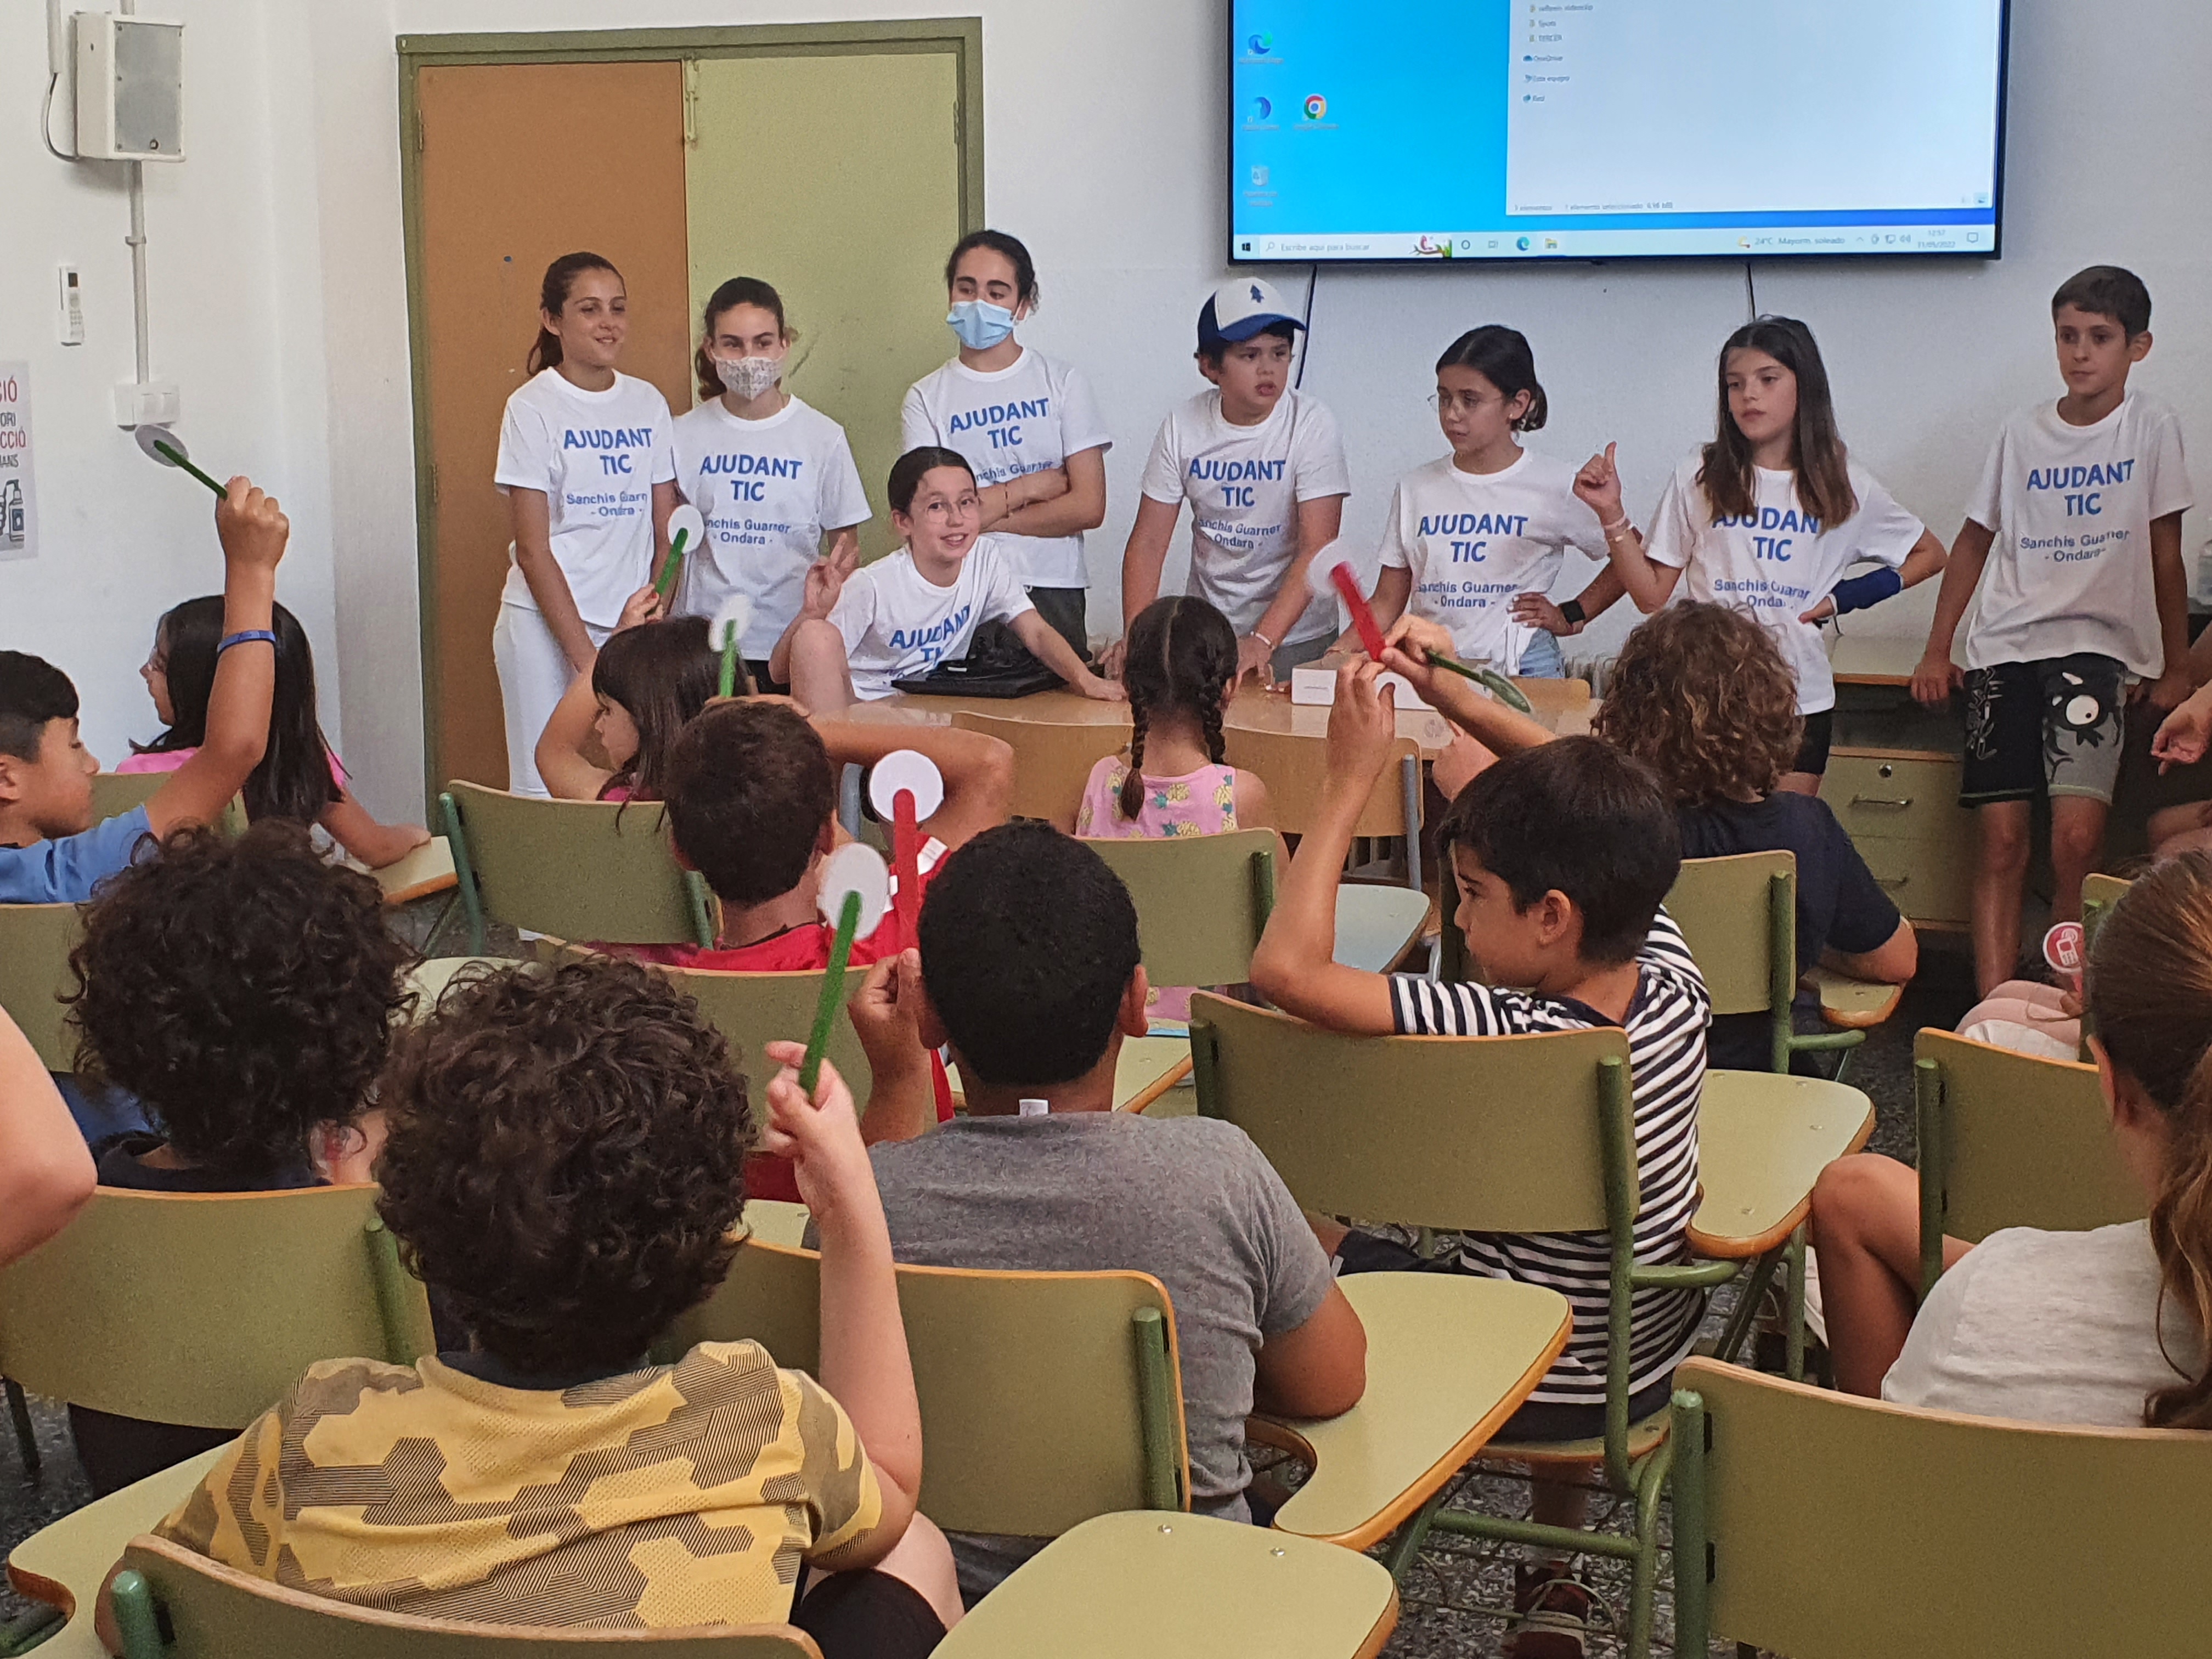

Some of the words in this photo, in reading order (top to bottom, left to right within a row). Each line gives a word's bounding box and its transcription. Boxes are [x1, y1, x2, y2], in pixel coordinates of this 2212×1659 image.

[1281, 243, 1306, 251] Escribe
[1345, 243, 1369, 251] buscar
[950, 397, 1049, 434] AJUDANT
[563, 428, 652, 449] AJUDANT
[988, 426, 1023, 449] TIC
[599, 453, 632, 476] TIC
[699, 454, 803, 480] AJUDANT
[1188, 458, 1286, 482] AJUDANT
[2027, 459, 2135, 491] AJUDANT
[566, 493, 616, 505] Sanchis
[730, 479, 765, 501] TIC
[1221, 486, 1256, 507] TIC
[2064, 493, 2102, 517] TIC
[1235, 523, 1282, 536] Guarner
[1417, 514, 1529, 537] AJUDANT
[720, 532, 765, 545] Ondara
[1214, 533, 1254, 549] Ondara
[1752, 536, 1792, 562] TIC
[2019, 535, 2075, 549] Sanchis
[1450, 541, 1487, 562] TIC
[1714, 579, 1768, 592] Sanchis
[1440, 595, 1486, 608] Ondara
